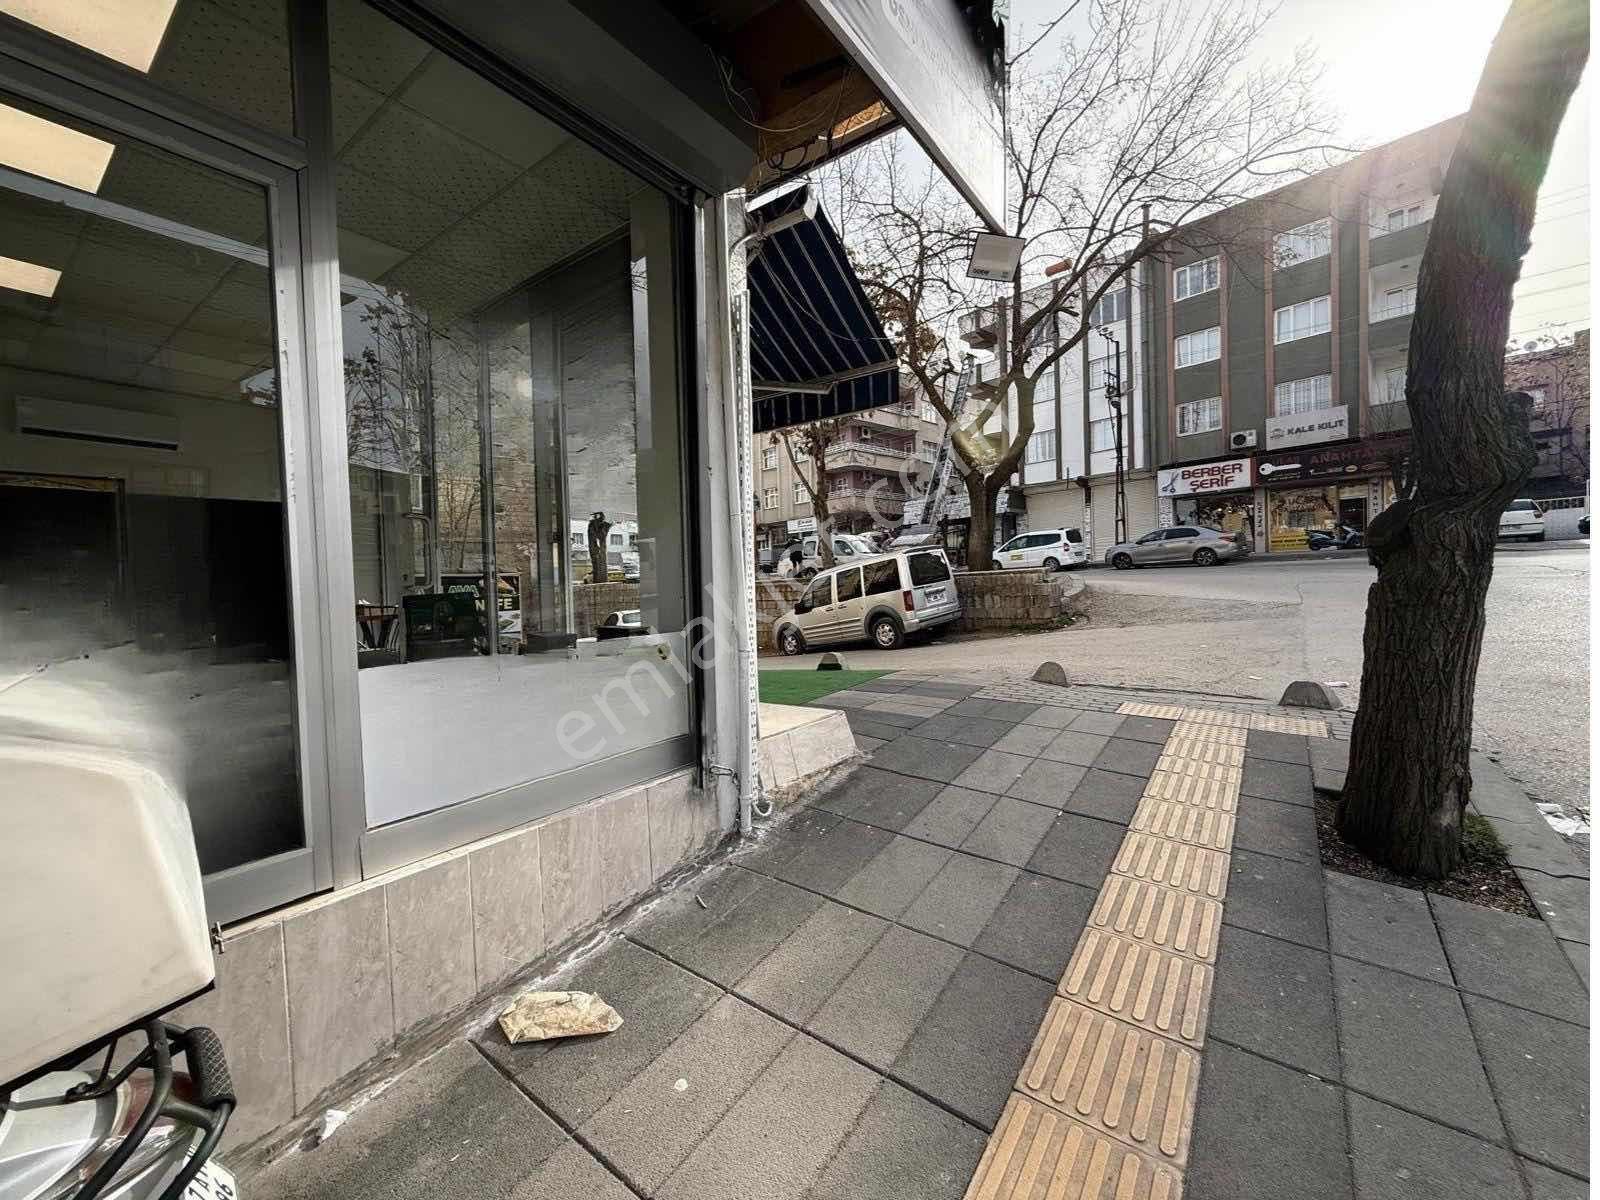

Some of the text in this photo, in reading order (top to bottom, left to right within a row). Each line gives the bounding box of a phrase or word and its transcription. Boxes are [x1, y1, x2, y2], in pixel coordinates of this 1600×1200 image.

[1287, 424, 1315, 435] KALE
[1181, 463, 1243, 479] BERBER
[1190, 474, 1235, 492] ŞERİF
